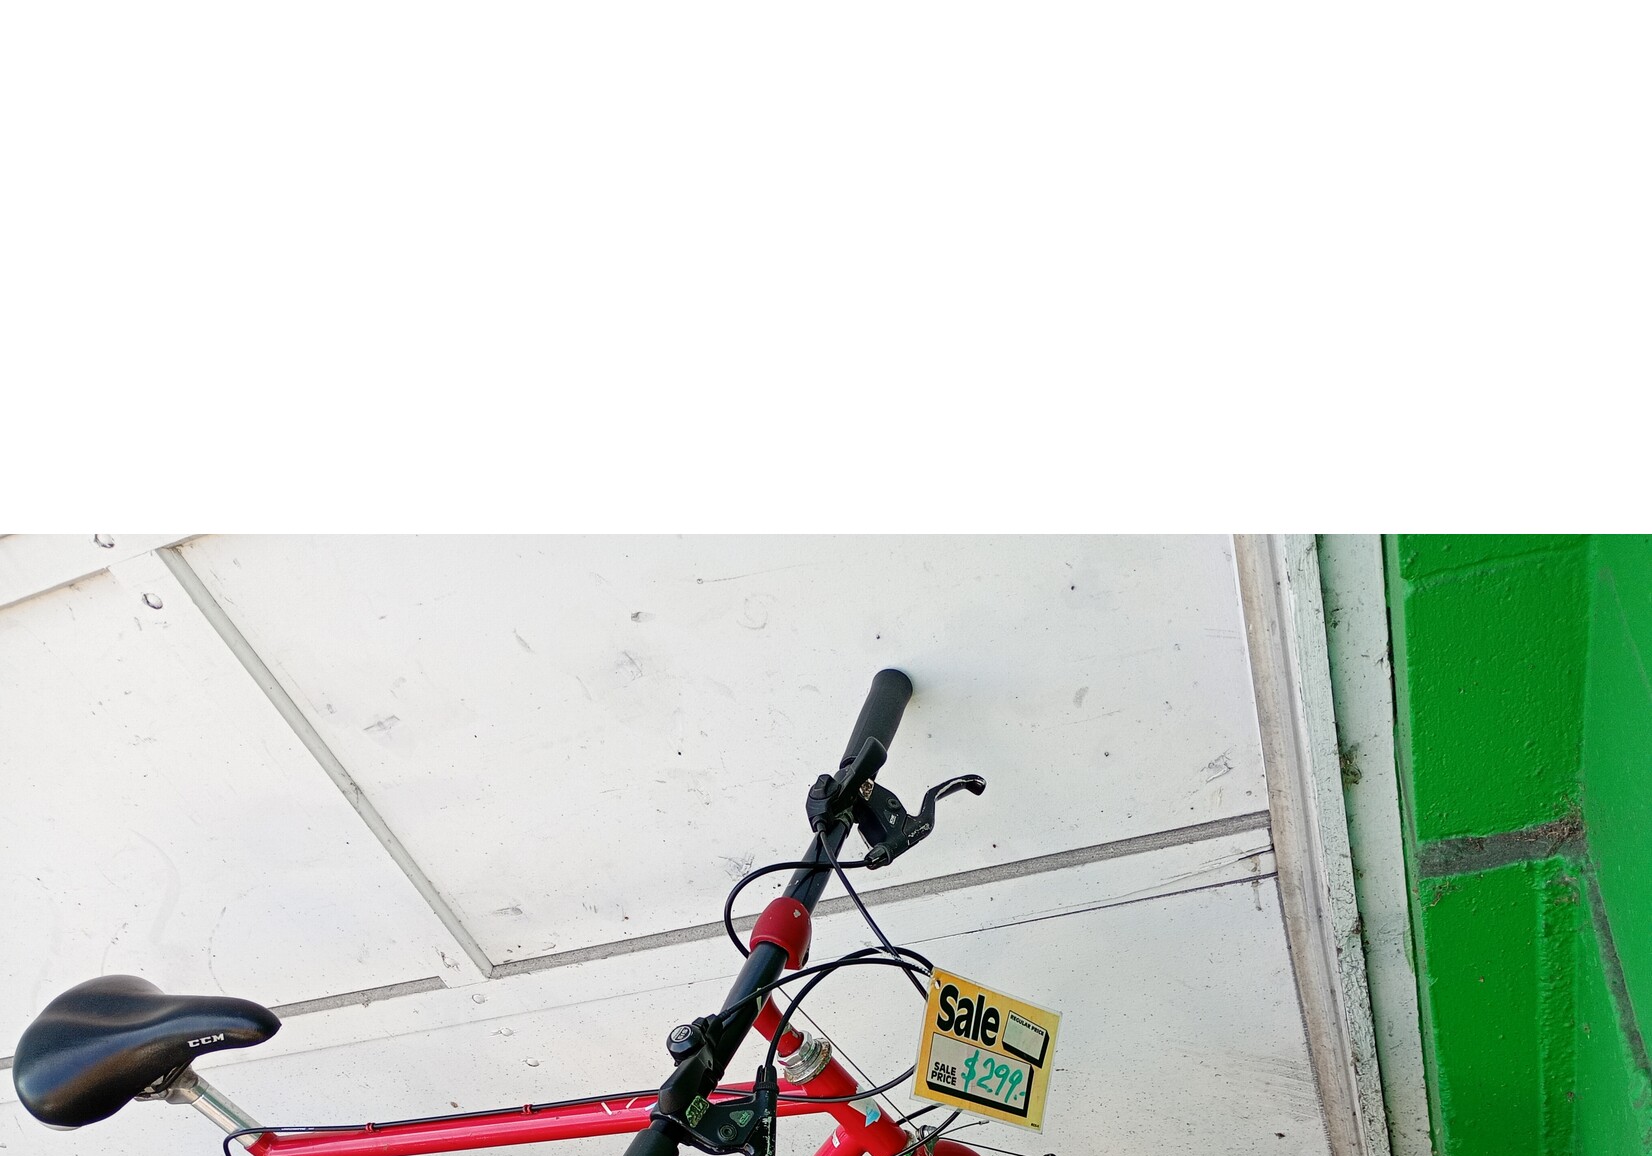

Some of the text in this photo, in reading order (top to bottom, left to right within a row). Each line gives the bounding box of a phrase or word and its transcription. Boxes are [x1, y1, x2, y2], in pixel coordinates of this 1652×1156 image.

[937, 984, 1000, 1046] Sale
[1010, 1014, 1045, 1036] REGULAR PRICE
[187, 1033, 225, 1048] CCM
[934, 1061, 957, 1077] SALE
[931, 1070, 957, 1086] PRICE
